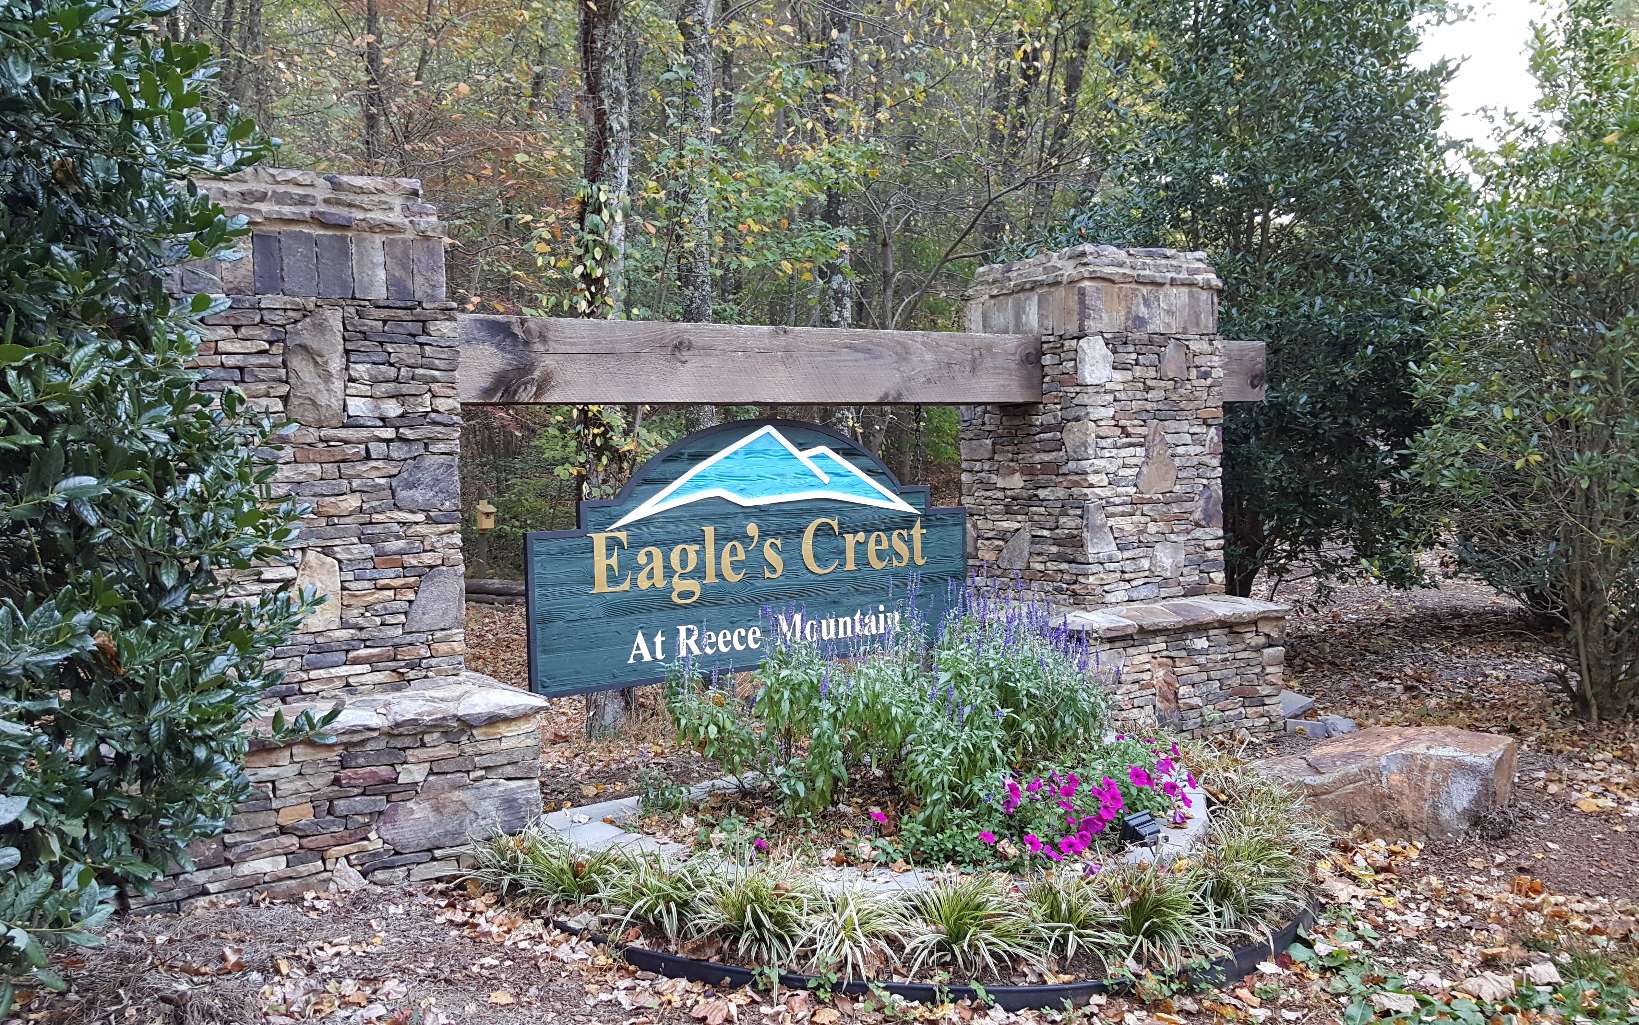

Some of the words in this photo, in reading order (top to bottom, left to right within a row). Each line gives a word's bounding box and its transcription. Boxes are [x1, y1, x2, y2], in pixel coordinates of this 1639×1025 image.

[587, 522, 785, 605] Eagle's
[801, 516, 928, 575] Crest
[627, 630, 667, 664] At
[675, 624, 762, 658] Reece
[775, 604, 902, 644] Mountain
